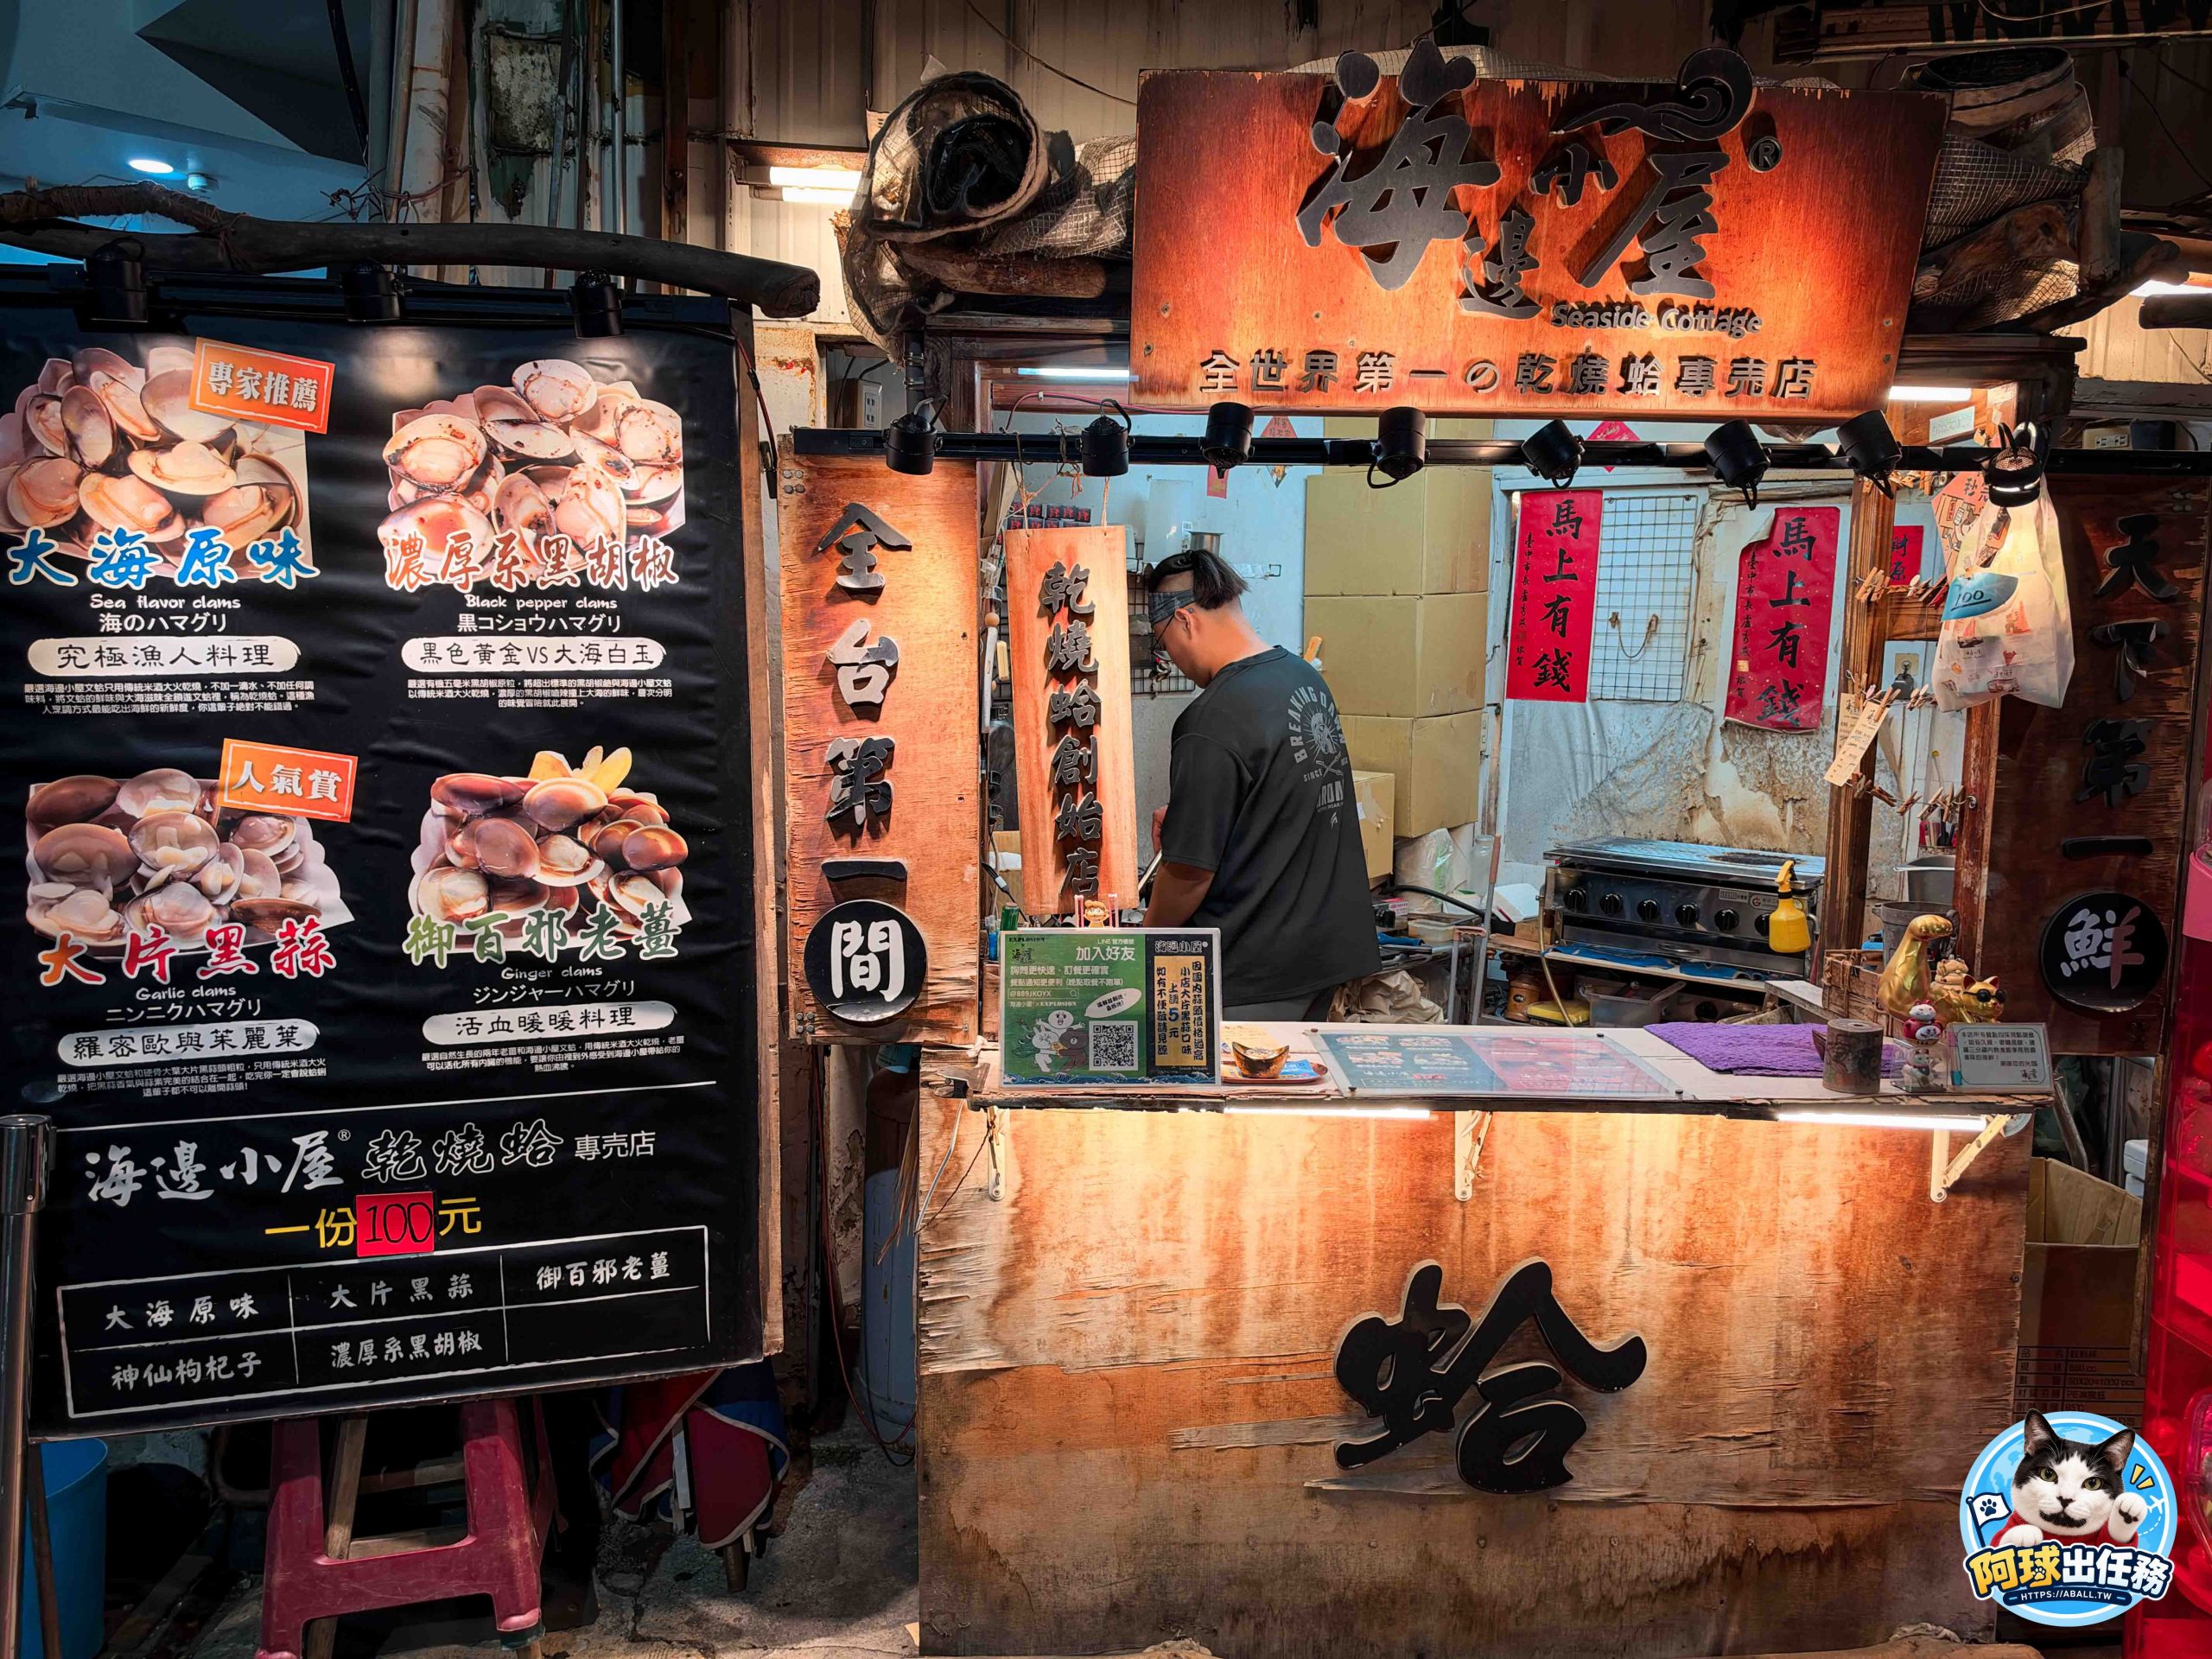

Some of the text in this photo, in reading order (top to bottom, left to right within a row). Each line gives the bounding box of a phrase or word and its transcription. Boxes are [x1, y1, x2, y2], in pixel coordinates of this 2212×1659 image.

[1295, 37, 1755, 321] 海邊小屋
[1551, 303, 1764, 340] Seaside Cottage
[207, 360, 318, 413] 專家推薦
[6, 524, 321, 591] 大海原味
[385, 528, 680, 594] 濃厚系黑胡椒
[90, 594, 241, 610] Sea flavor clams
[465, 594, 618, 611] Black pepper clams
[1531, 498, 1583, 693] 馬上有錢
[1954, 588, 1986, 607] 100
[99, 612, 227, 634] 海のハマグリ
[457, 613, 621, 633] 黒コショウハマグリ
[1755, 516, 1816, 728] 馬上有錢
[56, 643, 275, 670] 究極漁人料理
[419, 642, 654, 666] 黑色黃金VS大海白玉
[1040, 559, 1105, 899] 乾燒蛤創始店
[1287, 686, 1319, 765] BREAKING
[232, 760, 343, 804] 人氣賞
[1303, 769, 1324, 783] SINCE
[38, 915, 337, 987] 大片黑蒜
[402, 899, 683, 969] 御百邪老薑
[1076, 945, 1135, 962] 加入好友
[136, 985, 237, 1001] Garlic clams
[473, 980, 635, 1005] ジンジャーハマグリ
[500, 965, 603, 982] Ginger clams
[106, 999, 262, 1022] ニンニクハマグリ
[455, 1007, 636, 1037] 活血暖暖料理
[1180, 966, 1192, 1055] 小店大片黑蒜口味
[73, 1025, 303, 1061] 羅密歐與茱麗葉
[85, 1128, 344, 1207] 海邊小屋
[359, 1119, 565, 1185] 乾燒蛤
[329, 1273, 474, 1310] 大片黑蒜
[536, 1250, 671, 1292] 御百邪老薑
[105, 1290, 260, 1334] 大海原味
[330, 1329, 484, 1370] 濃厚系黑胡椒
[111, 1351, 263, 1393] 神仙枸杞子
[1334, 1256, 1648, 1495] 蛤
